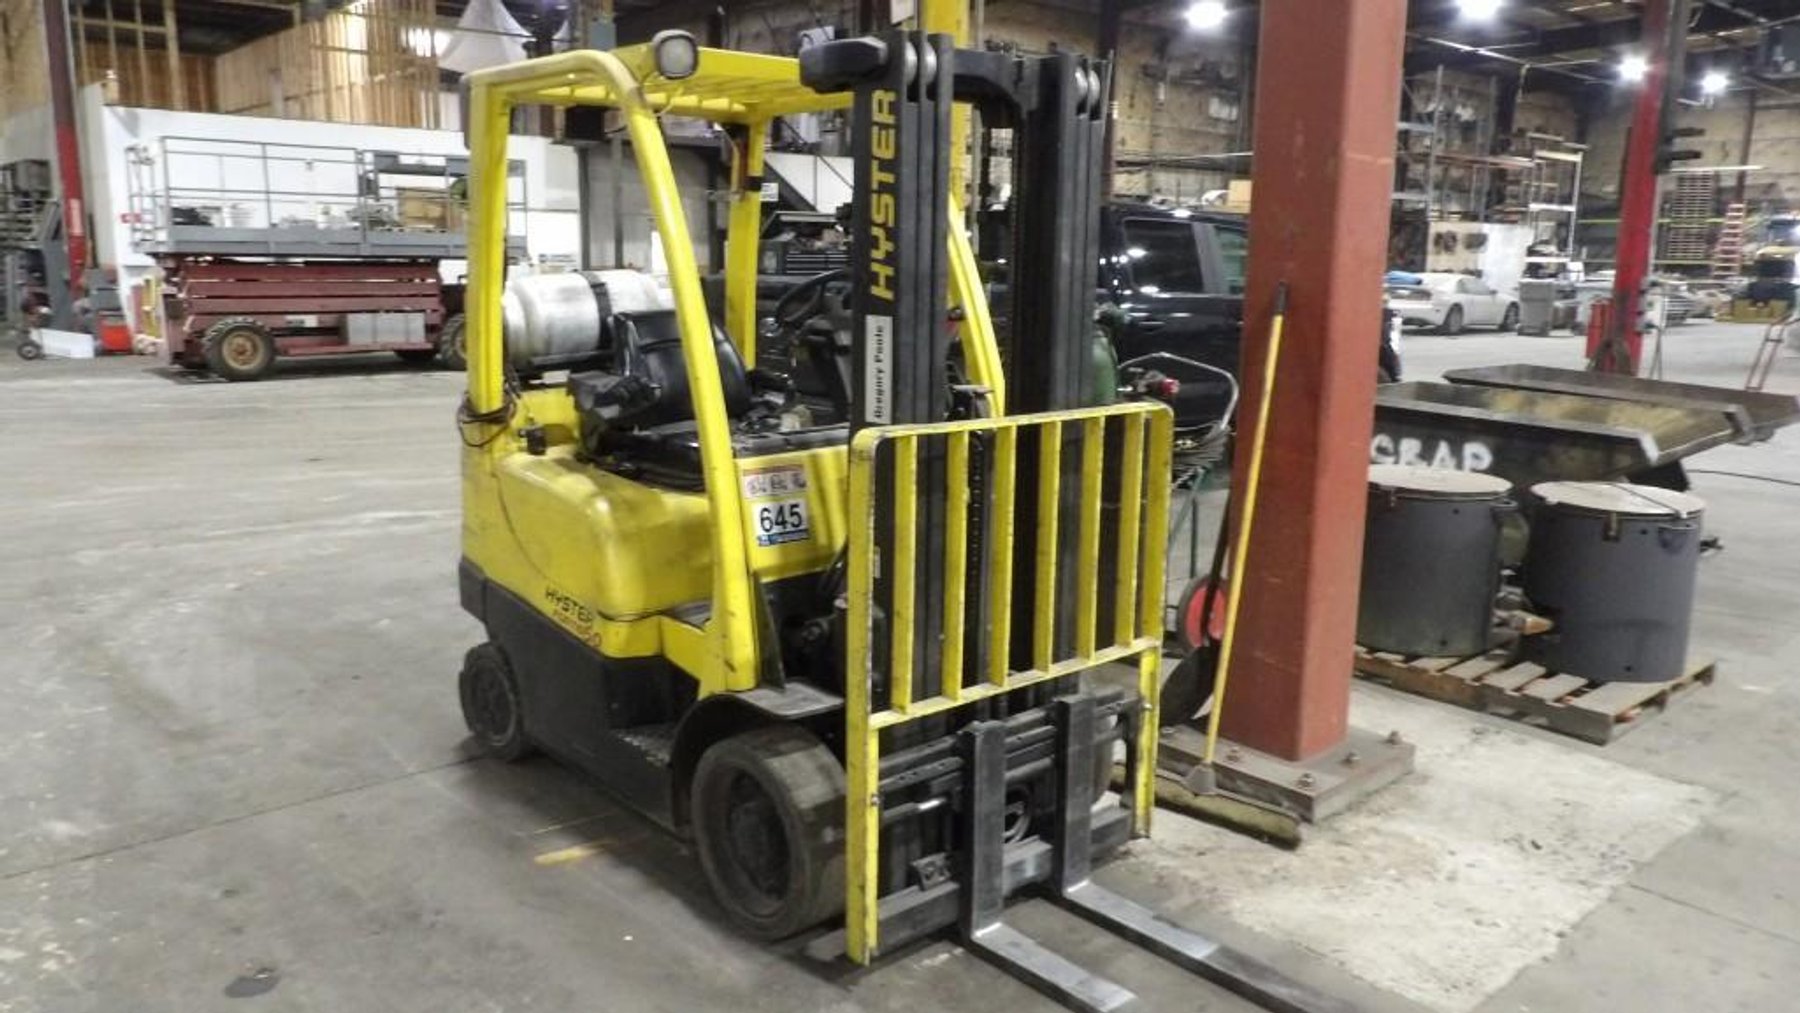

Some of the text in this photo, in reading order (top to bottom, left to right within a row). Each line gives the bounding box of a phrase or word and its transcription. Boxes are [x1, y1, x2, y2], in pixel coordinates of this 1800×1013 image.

[871, 89, 897, 299] HYSTER
[873, 325, 886, 418] Gregory Poole
[760, 504, 803, 533] 645
